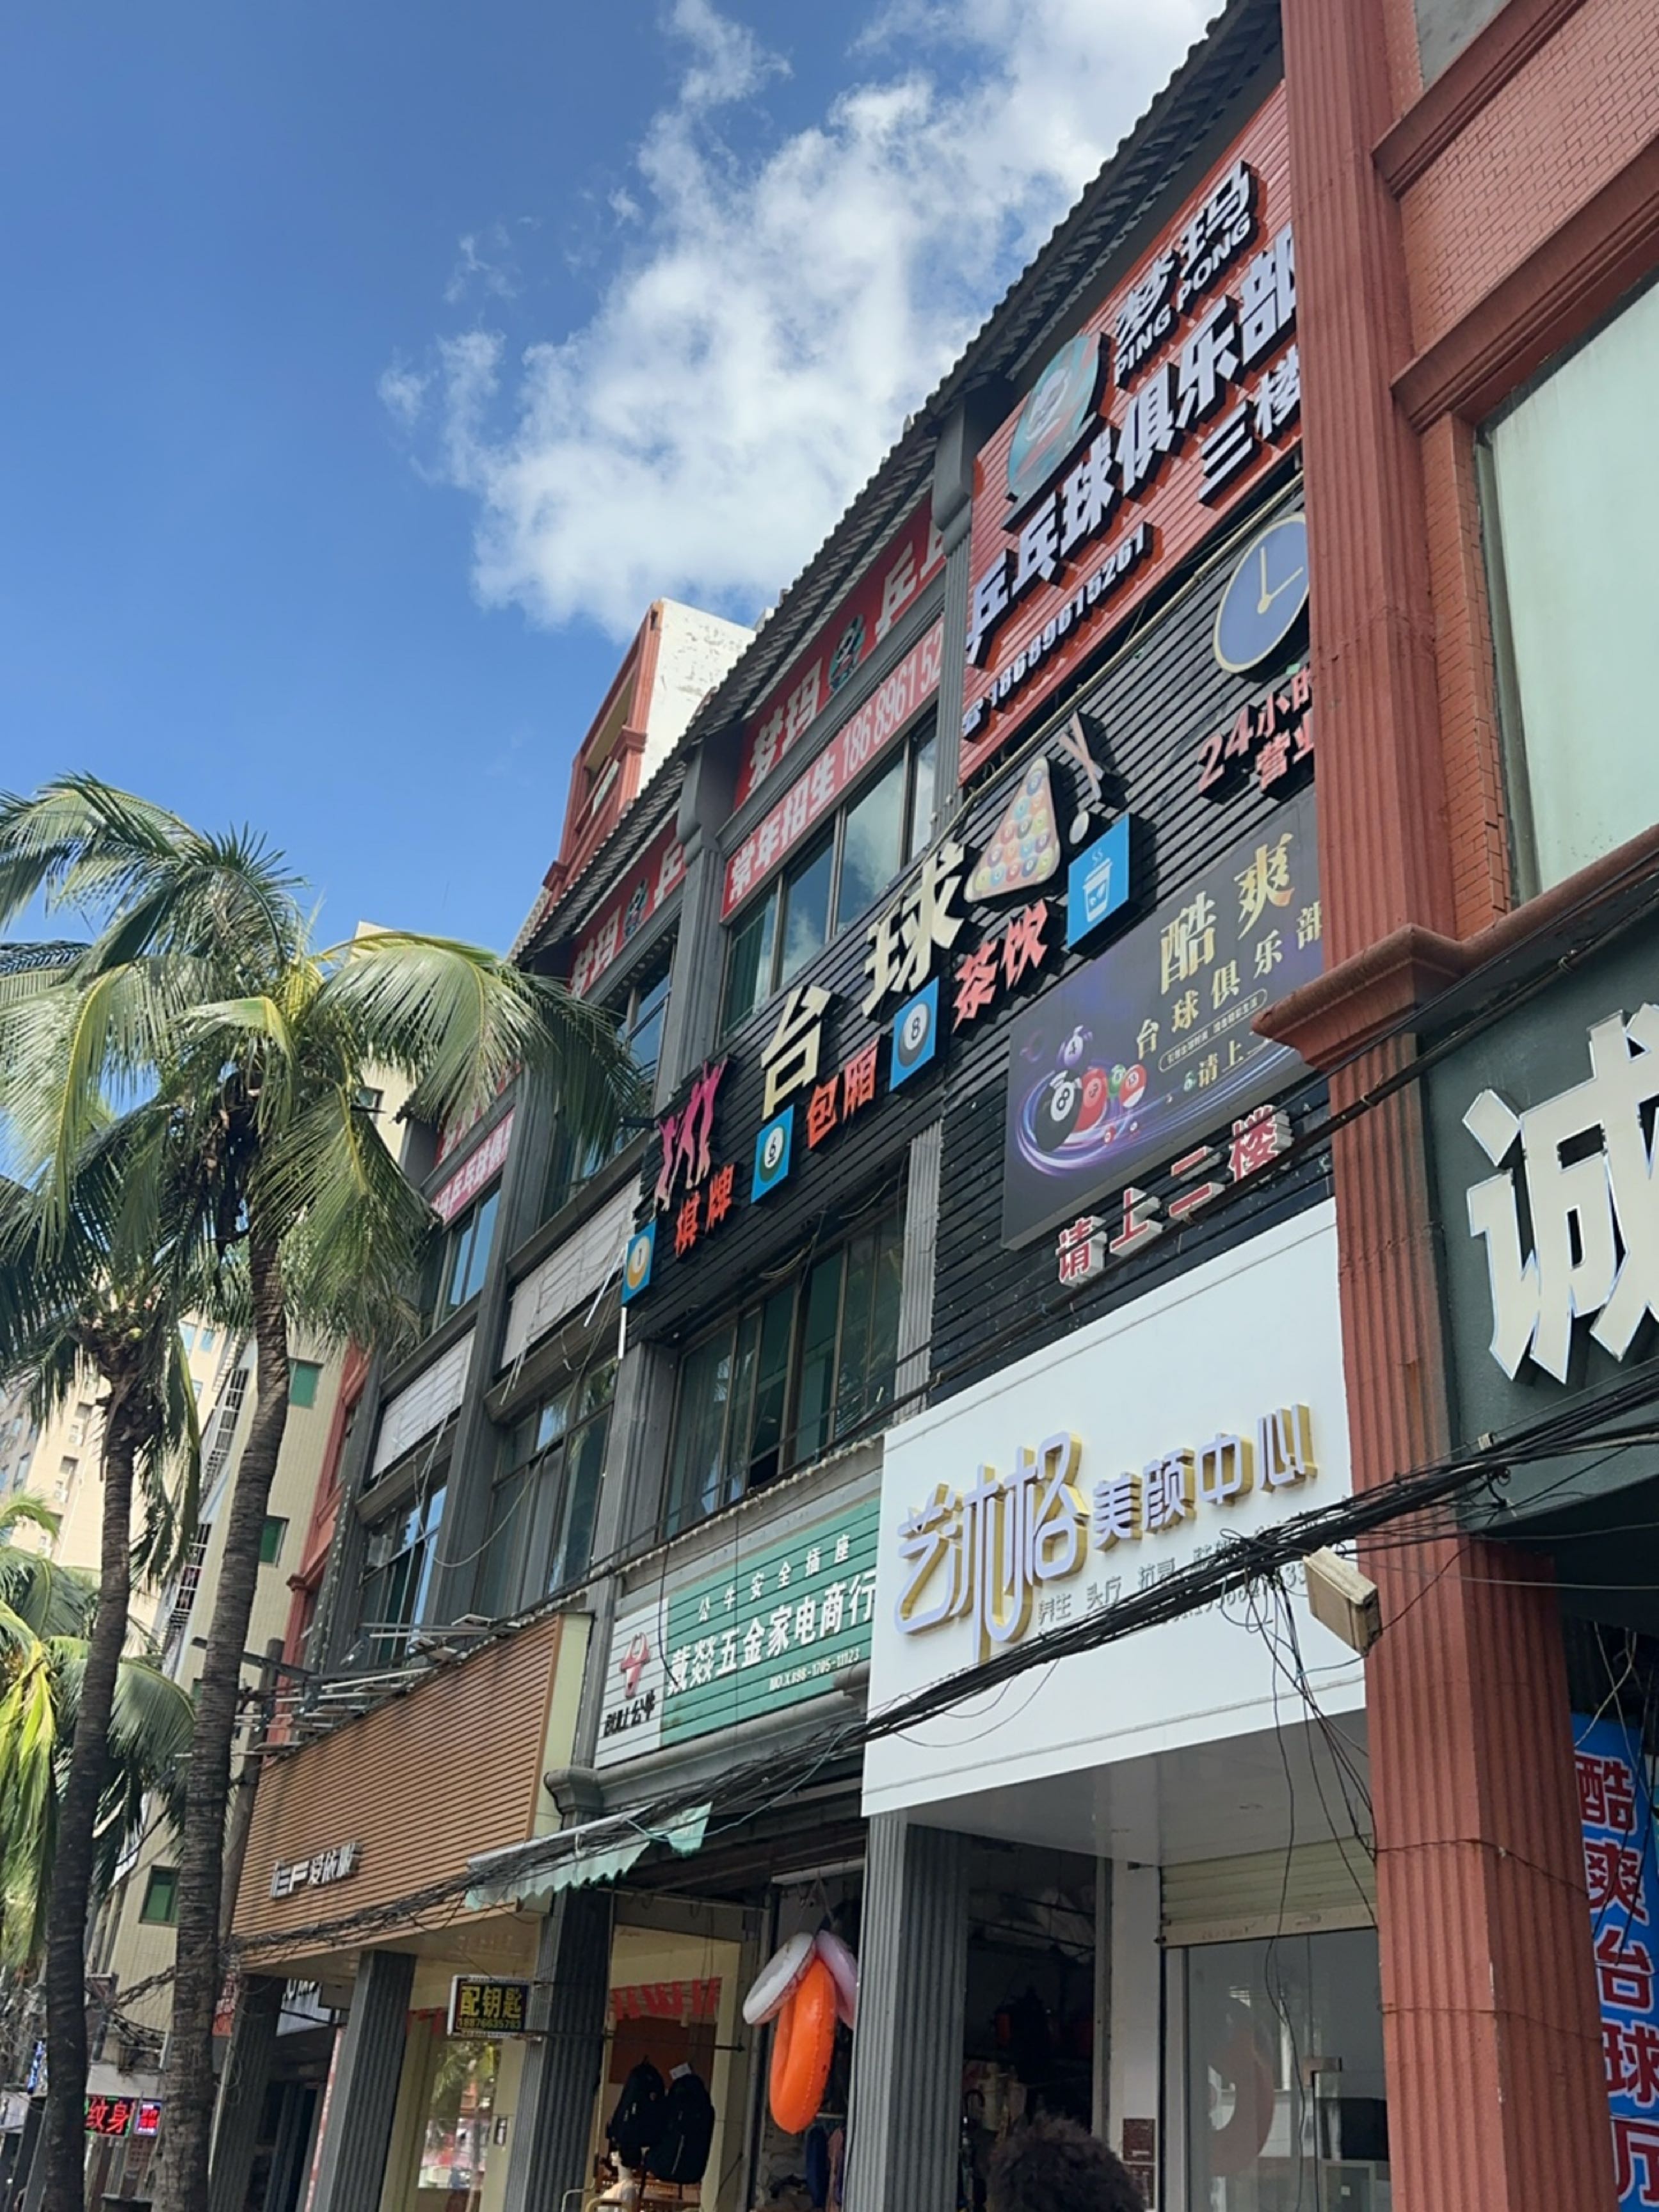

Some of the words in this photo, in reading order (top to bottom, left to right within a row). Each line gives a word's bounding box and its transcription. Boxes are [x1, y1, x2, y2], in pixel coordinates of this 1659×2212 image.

[1114, 304, 1171, 385] PING
[1176, 211, 1250, 312] PONG
[966, 221, 1297, 664] 乒乓球俱乐部
[1198, 344, 1300, 499] 三楼
[990, 522, 1145, 707] 18689615261
[729, 753, 836, 904] 常年招生
[760, 841, 965, 1123] 台球
[952, 897, 1048, 1034] 茶饮
[1135, 901, 1322, 1061] 台球俱乐部
[1160, 833, 1295, 996] 酷爽
[806, 1033, 880, 1150] 包厢
[675, 1164, 735, 1259] 棋牌
[1056, 1105, 1279, 1283] 请上二楼
[1093, 1403, 1310, 1550] 美颜中心
[699, 1534, 850, 1622] 公牛安全插座
[460, 1985, 523, 2019] 配钥匙
